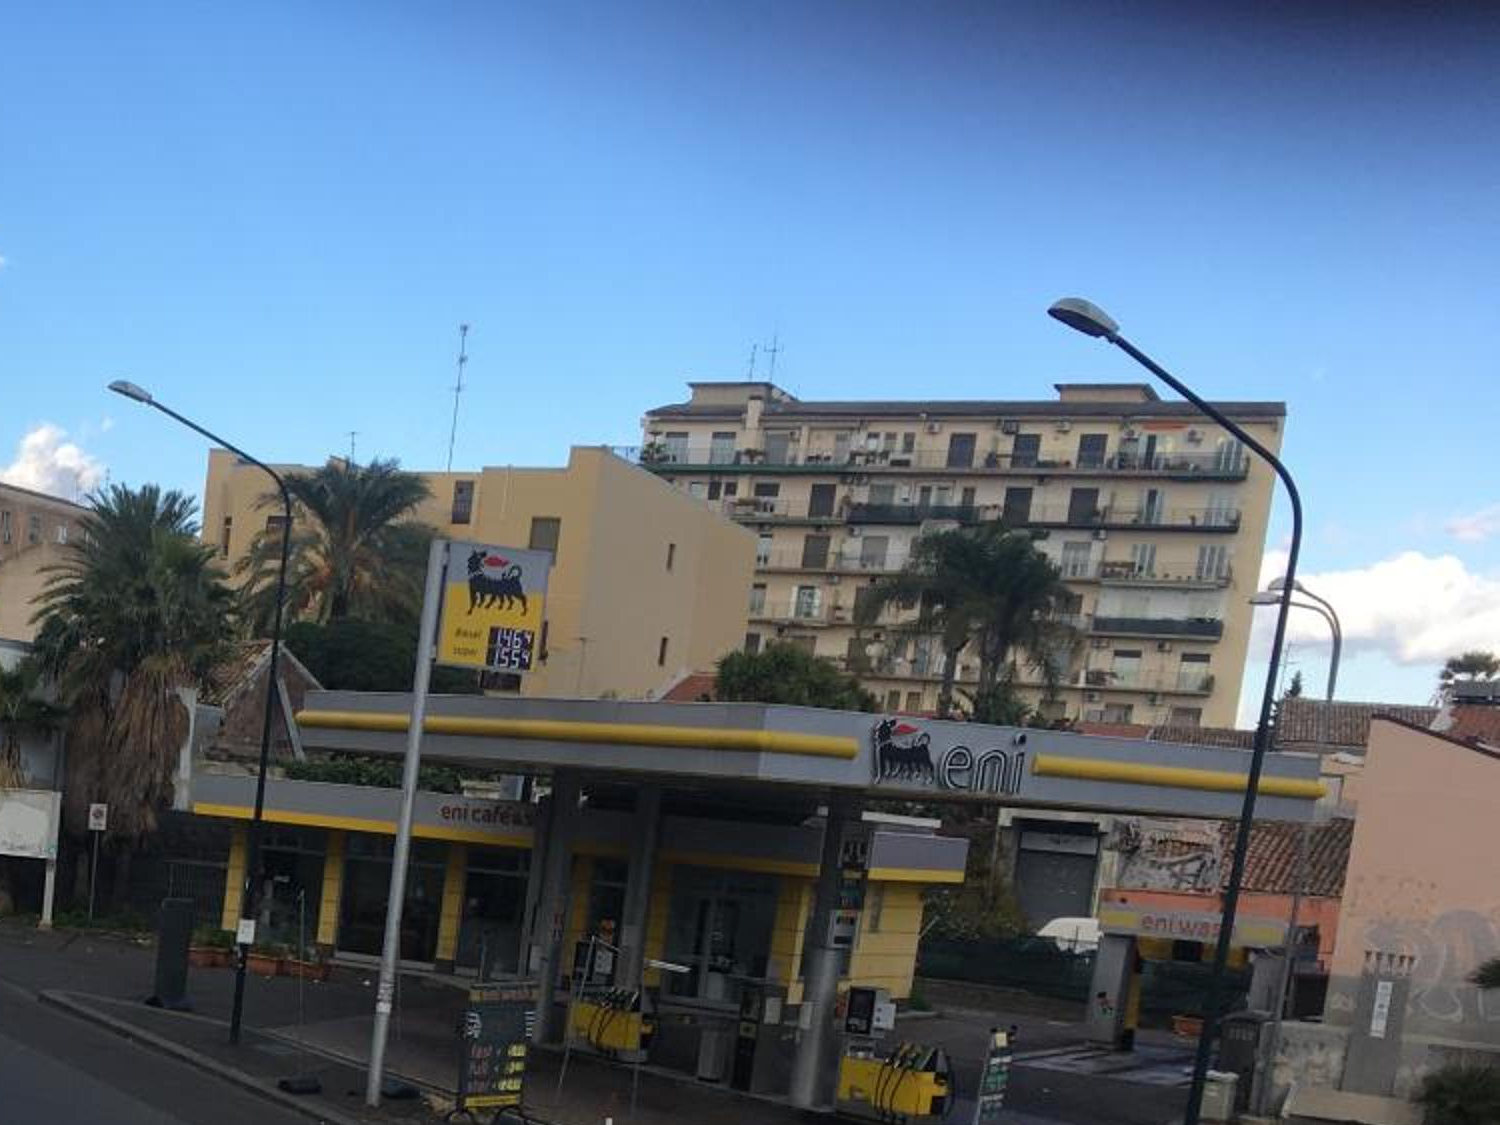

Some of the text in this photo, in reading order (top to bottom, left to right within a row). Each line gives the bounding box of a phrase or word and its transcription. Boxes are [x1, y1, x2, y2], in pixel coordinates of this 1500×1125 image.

[940, 733, 1027, 795] eni
[440, 804, 467, 821] eni
[1140, 912, 1173, 930] eni
